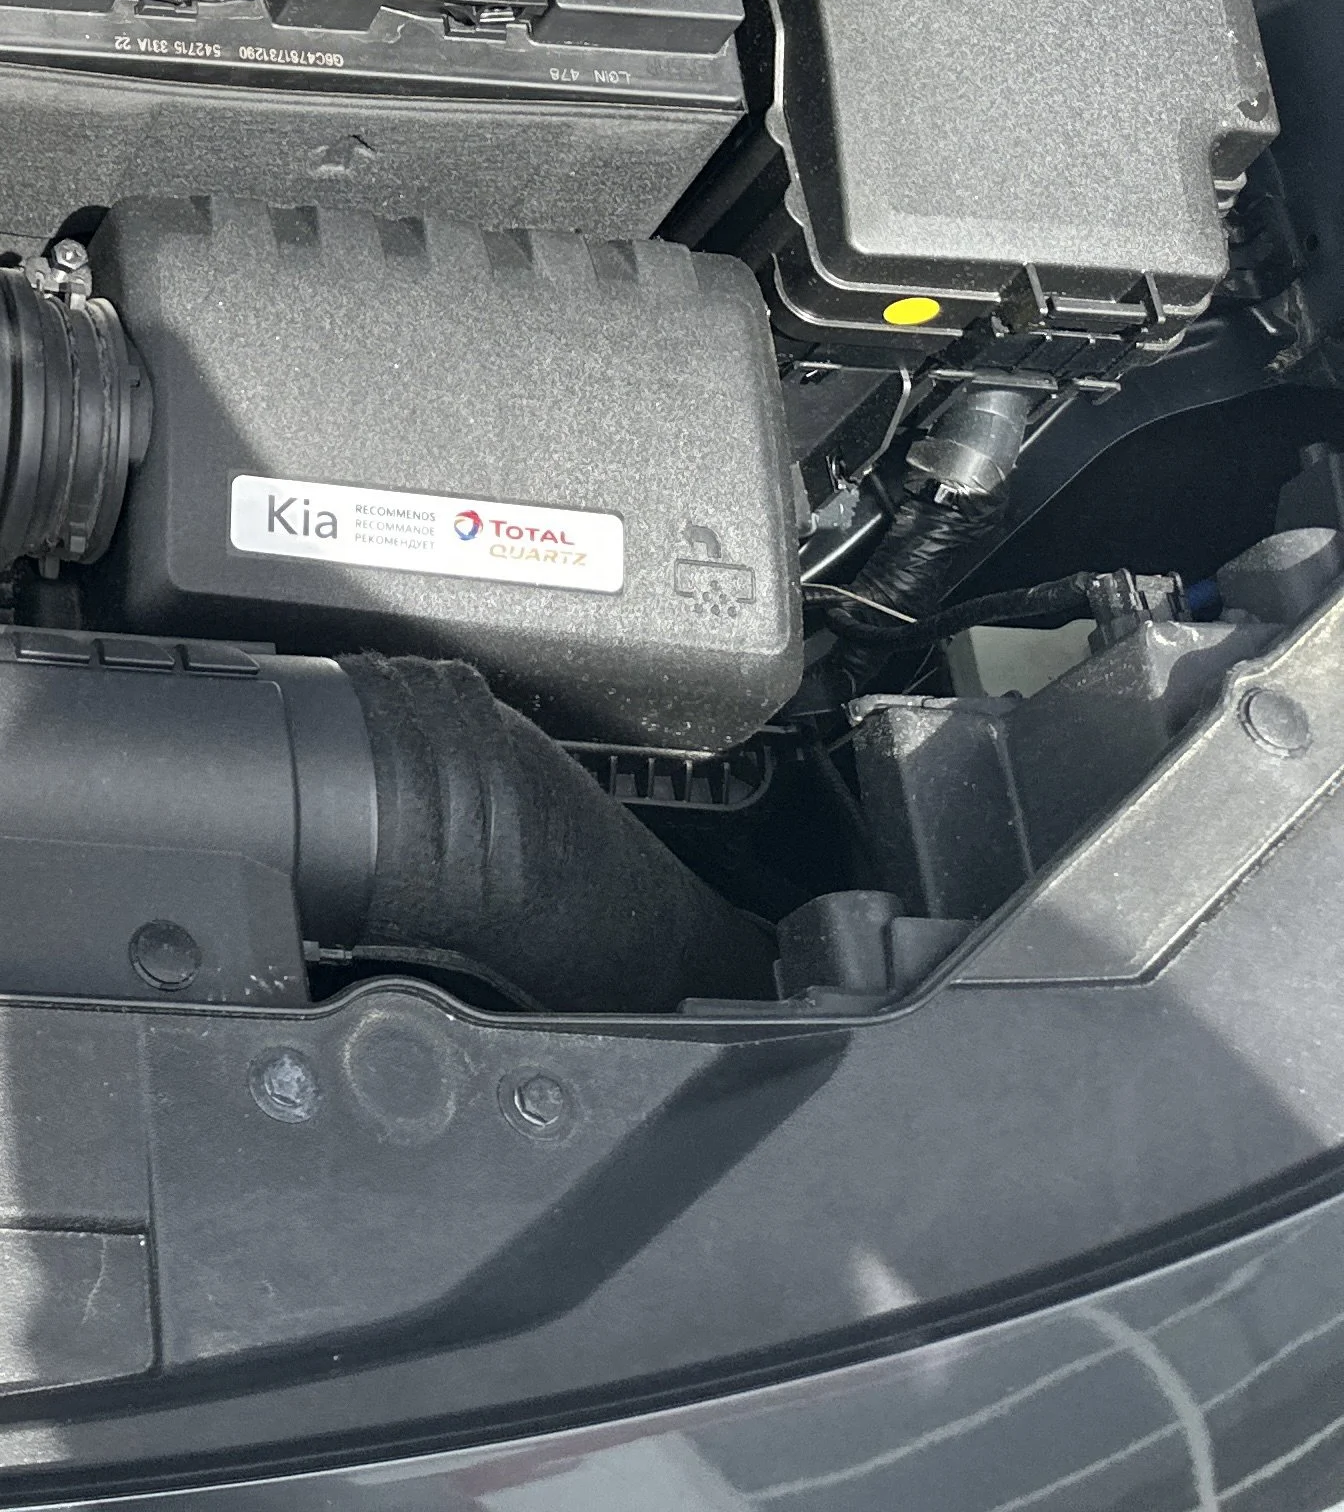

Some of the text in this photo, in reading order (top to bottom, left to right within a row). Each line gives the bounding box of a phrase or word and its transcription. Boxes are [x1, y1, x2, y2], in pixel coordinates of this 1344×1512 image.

[136, 37, 169, 54] 331A
[173, 39, 221, 58] 542715
[268, 494, 437, 540] Kia RECOMMENDS
[354, 518, 436, 537] RECOMMANDE
[488, 519, 575, 546] TOTAL
[488, 544, 588, 566] QUARTZ
